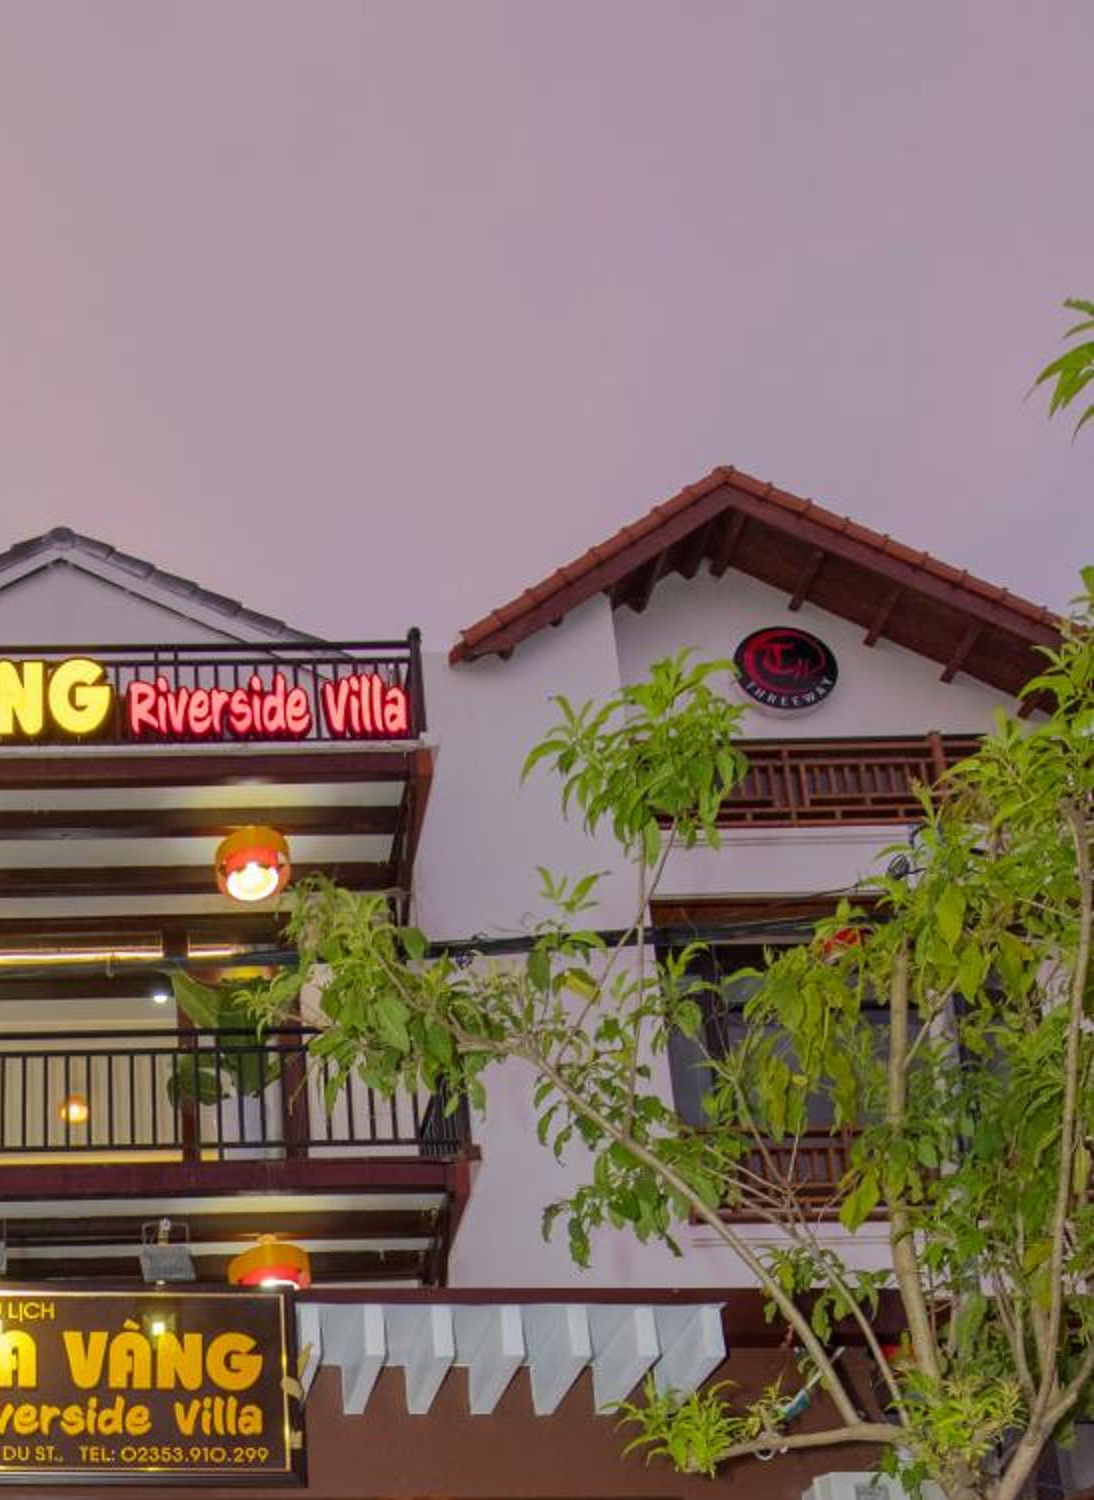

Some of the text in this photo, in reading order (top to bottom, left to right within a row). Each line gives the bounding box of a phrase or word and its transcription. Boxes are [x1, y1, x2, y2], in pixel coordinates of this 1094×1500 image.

[128, 672, 313, 735] Riverside
[323, 672, 408, 735] Villa
[7, 1301, 55, 1322] LỊCH
[62, 1319, 264, 1390] VÀNG
[173, 1395, 264, 1436] Villa
[3, 1446, 30, 1462] DU
[120, 1446, 269, 1463] 02353.910.299
